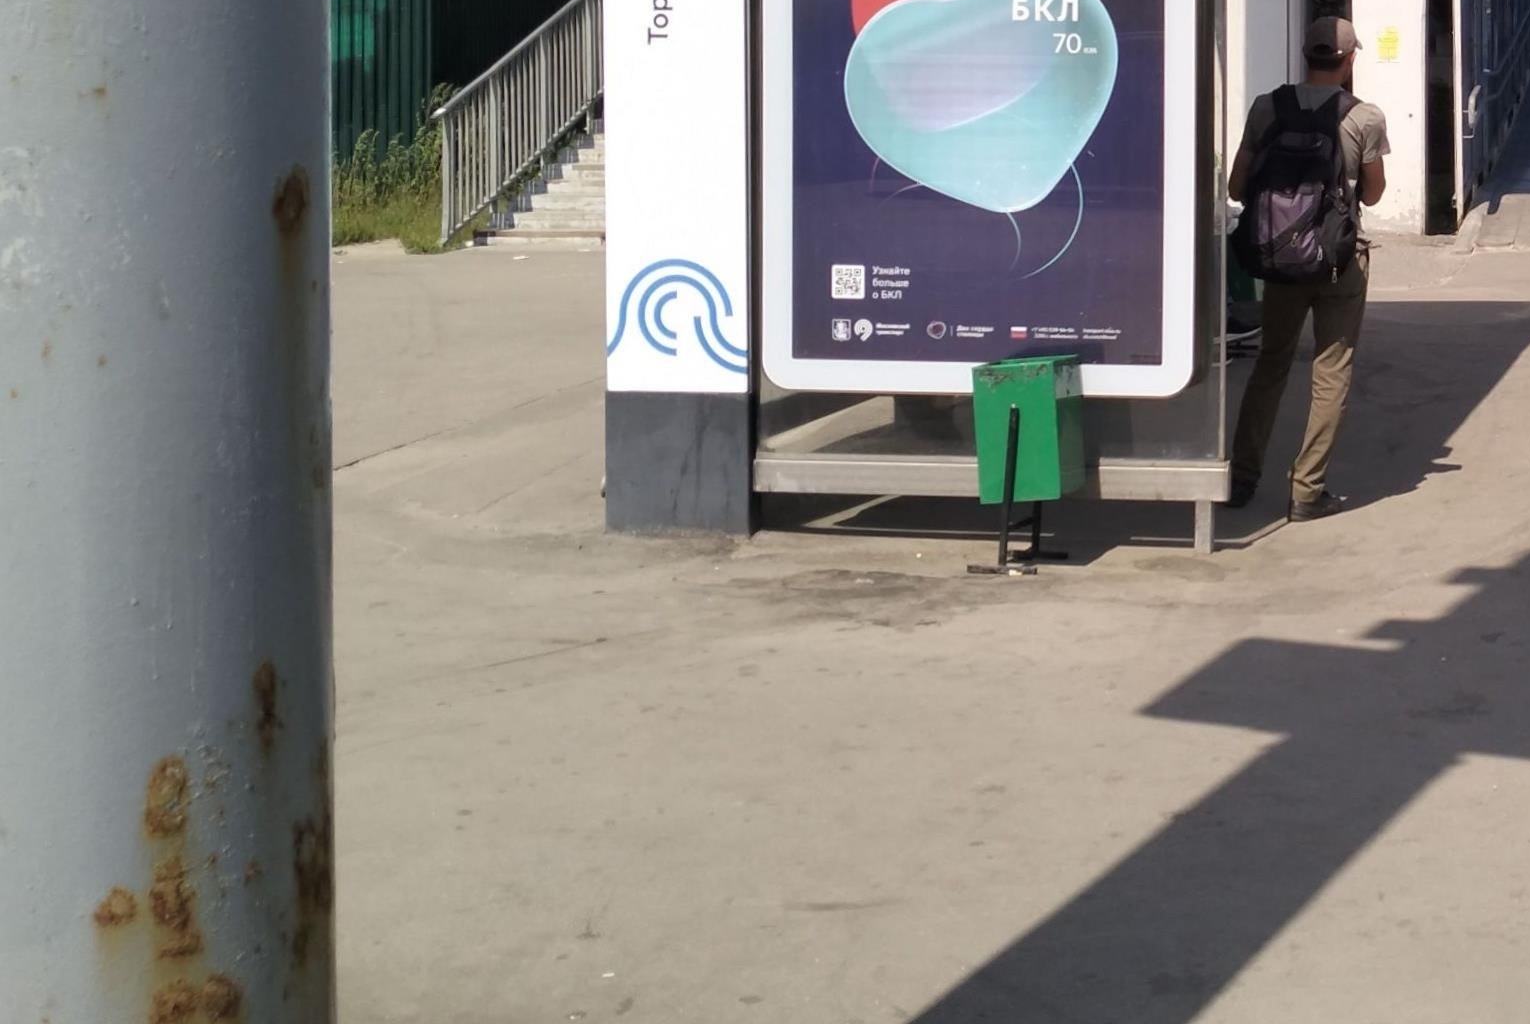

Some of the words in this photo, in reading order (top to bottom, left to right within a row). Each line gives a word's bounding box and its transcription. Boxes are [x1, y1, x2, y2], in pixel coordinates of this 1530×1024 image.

[1052, 32, 1082, 54] 70
[872, 291, 879, 299] о
[881, 290, 903, 299] БКЛ
